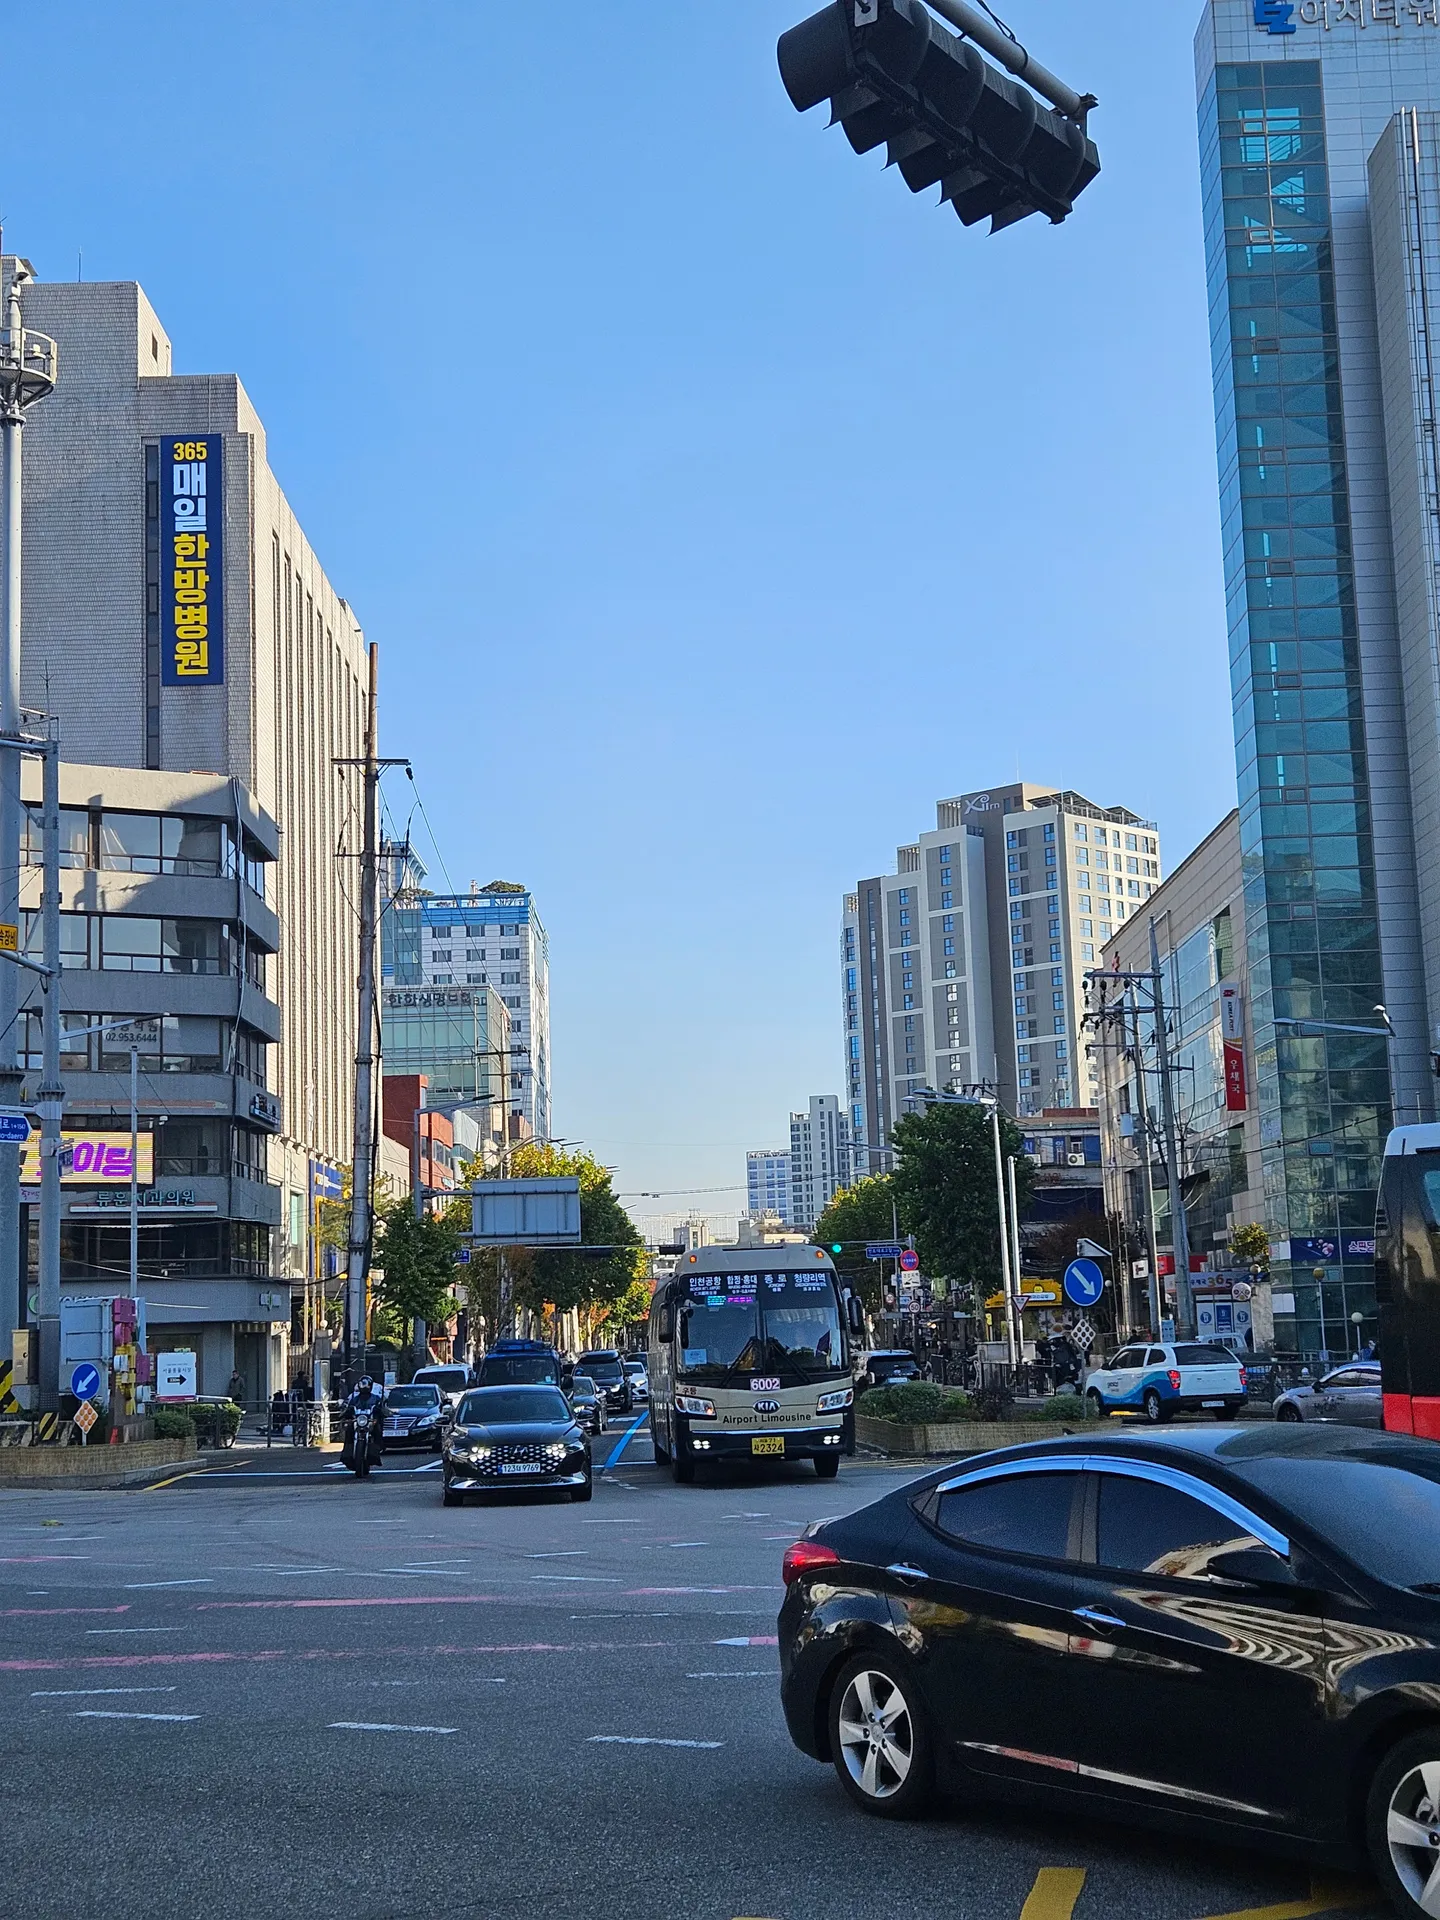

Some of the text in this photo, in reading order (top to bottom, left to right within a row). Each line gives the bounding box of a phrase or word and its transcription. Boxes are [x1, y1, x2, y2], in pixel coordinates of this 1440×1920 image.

[173, 442, 208, 461] 365
[105, 1032, 157, 1042] 02.953.6444
[1230, 1060, 1240, 1093] 우체국
[0, 1118, 10, 1129] 로
[689, 1276, 721, 1287] 인천공항
[794, 1273, 826, 1283] 청량리역
[1207, 1274, 1232, 1288] 365
[911, 1302, 919, 1311] 50
[751, 1379, 780, 1391] 6002
[757, 1402, 776, 1411] KIA
[722, 1413, 812, 1425] Airport Limousine
